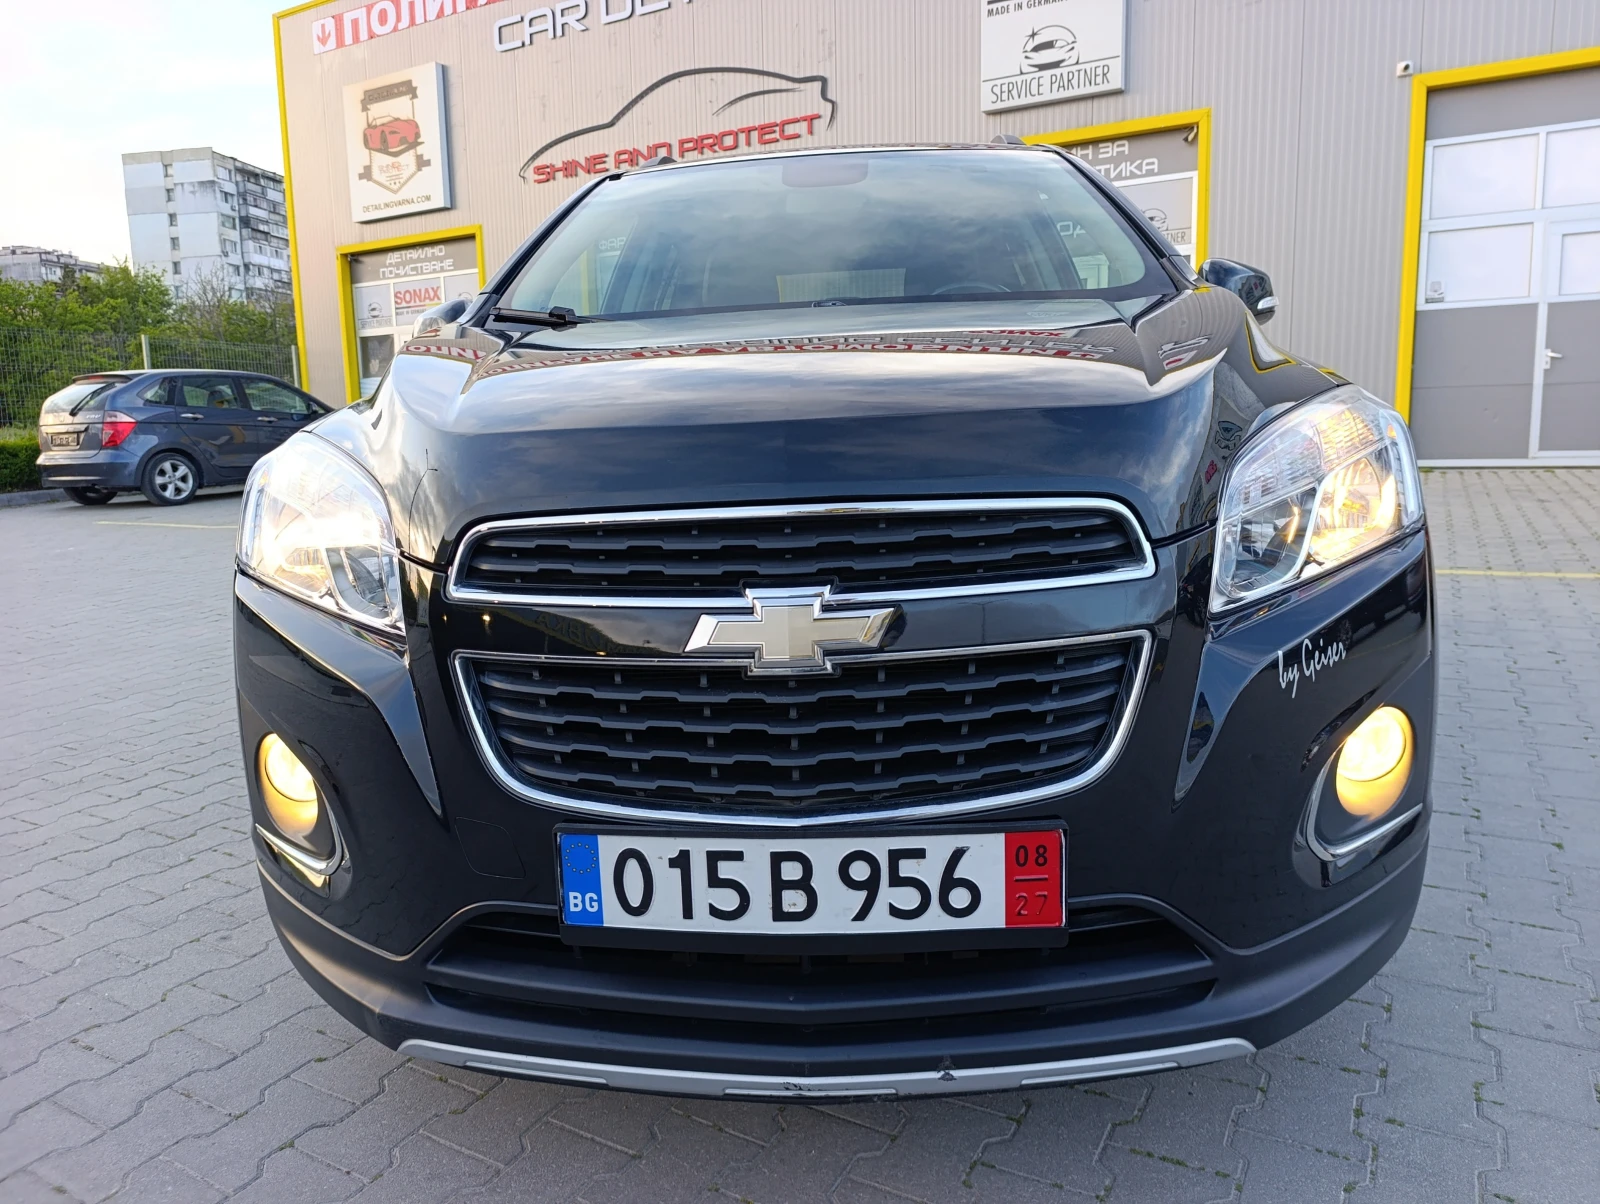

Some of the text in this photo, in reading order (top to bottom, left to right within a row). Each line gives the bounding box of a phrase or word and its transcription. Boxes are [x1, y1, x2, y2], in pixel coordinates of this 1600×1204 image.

[987, 4, 1010, 18] MADE
[1014, 2, 1023, 12] IN
[343, 0, 489, 45] ПОЛИ
[494, 0, 588, 51] CAR
[991, 64, 1110, 104] SERVICE PARTNER
[533, 113, 821, 184] SHINE AND PROTECT
[1094, 157, 1158, 179] ТИКА
[363, 195, 432, 213] DETAILINGVARNA.COM
[1163, 231, 1186, 244] TNER
[380, 259, 454, 279] ПОЧИСТВАНЕ
[395, 286, 441, 305] SONAX
[1278, 638, 1346, 698] by Geiser
[1015, 843, 1049, 868] 08
[568, 892, 598, 913] BG
[1015, 892, 1049, 916] 27
